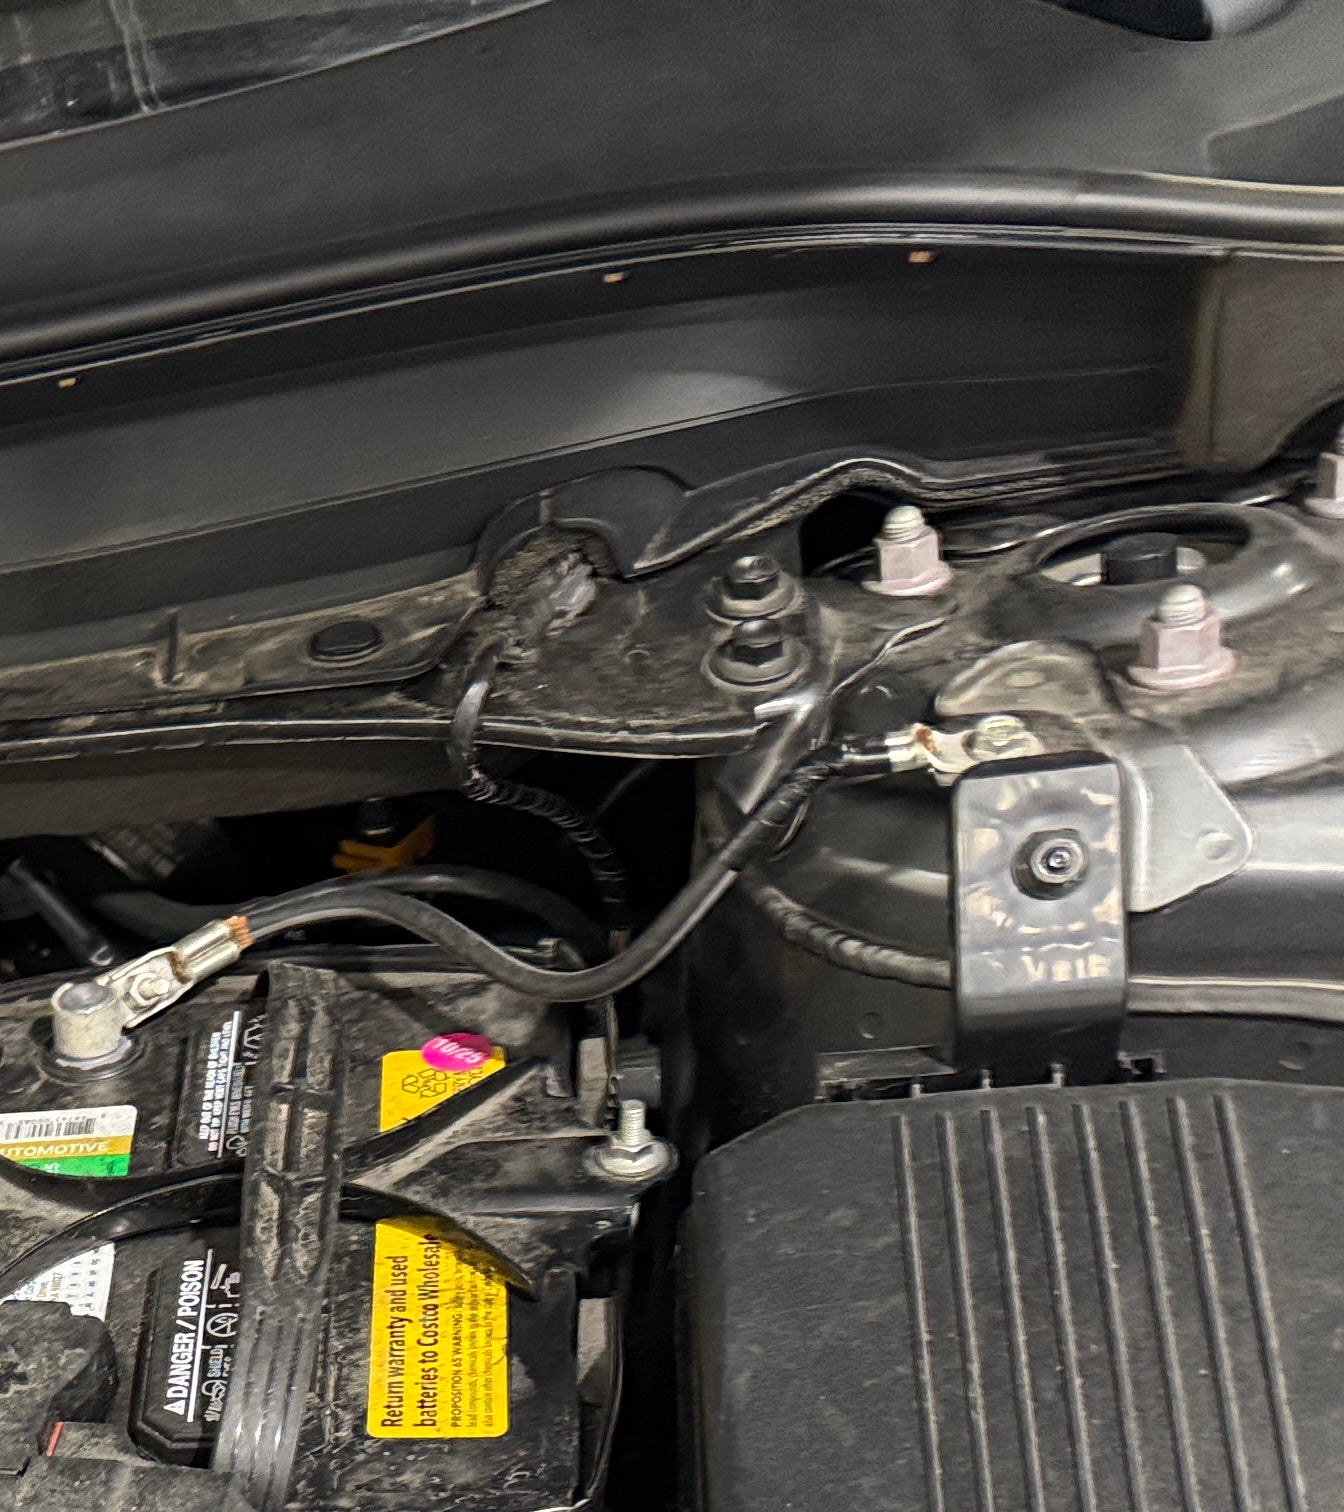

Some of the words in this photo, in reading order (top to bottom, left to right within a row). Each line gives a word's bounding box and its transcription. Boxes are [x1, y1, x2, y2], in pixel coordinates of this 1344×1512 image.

[433, 1038, 485, 1064] 10/25
[0, 1141, 109, 1158] UTOMOTIVE
[178, 1260, 204, 1316] POISON
[385, 1256, 408, 1285] used
[416, 1234, 441, 1300] Wholesale
[385, 1290, 407, 1312] and
[417, 1304, 439, 1346] Costco
[166, 1333, 196, 1398] DANGER
[207, 1349, 223, 1377] SHIELD
[387, 1316, 413, 1377] warranty
[419, 1351, 439, 1363] to
[451, 1358, 462, 1367] 65
[381, 1381, 404, 1427] Return
[413, 1368, 438, 1427] batteries
[451, 1370, 463, 1427] PROPOSITION
